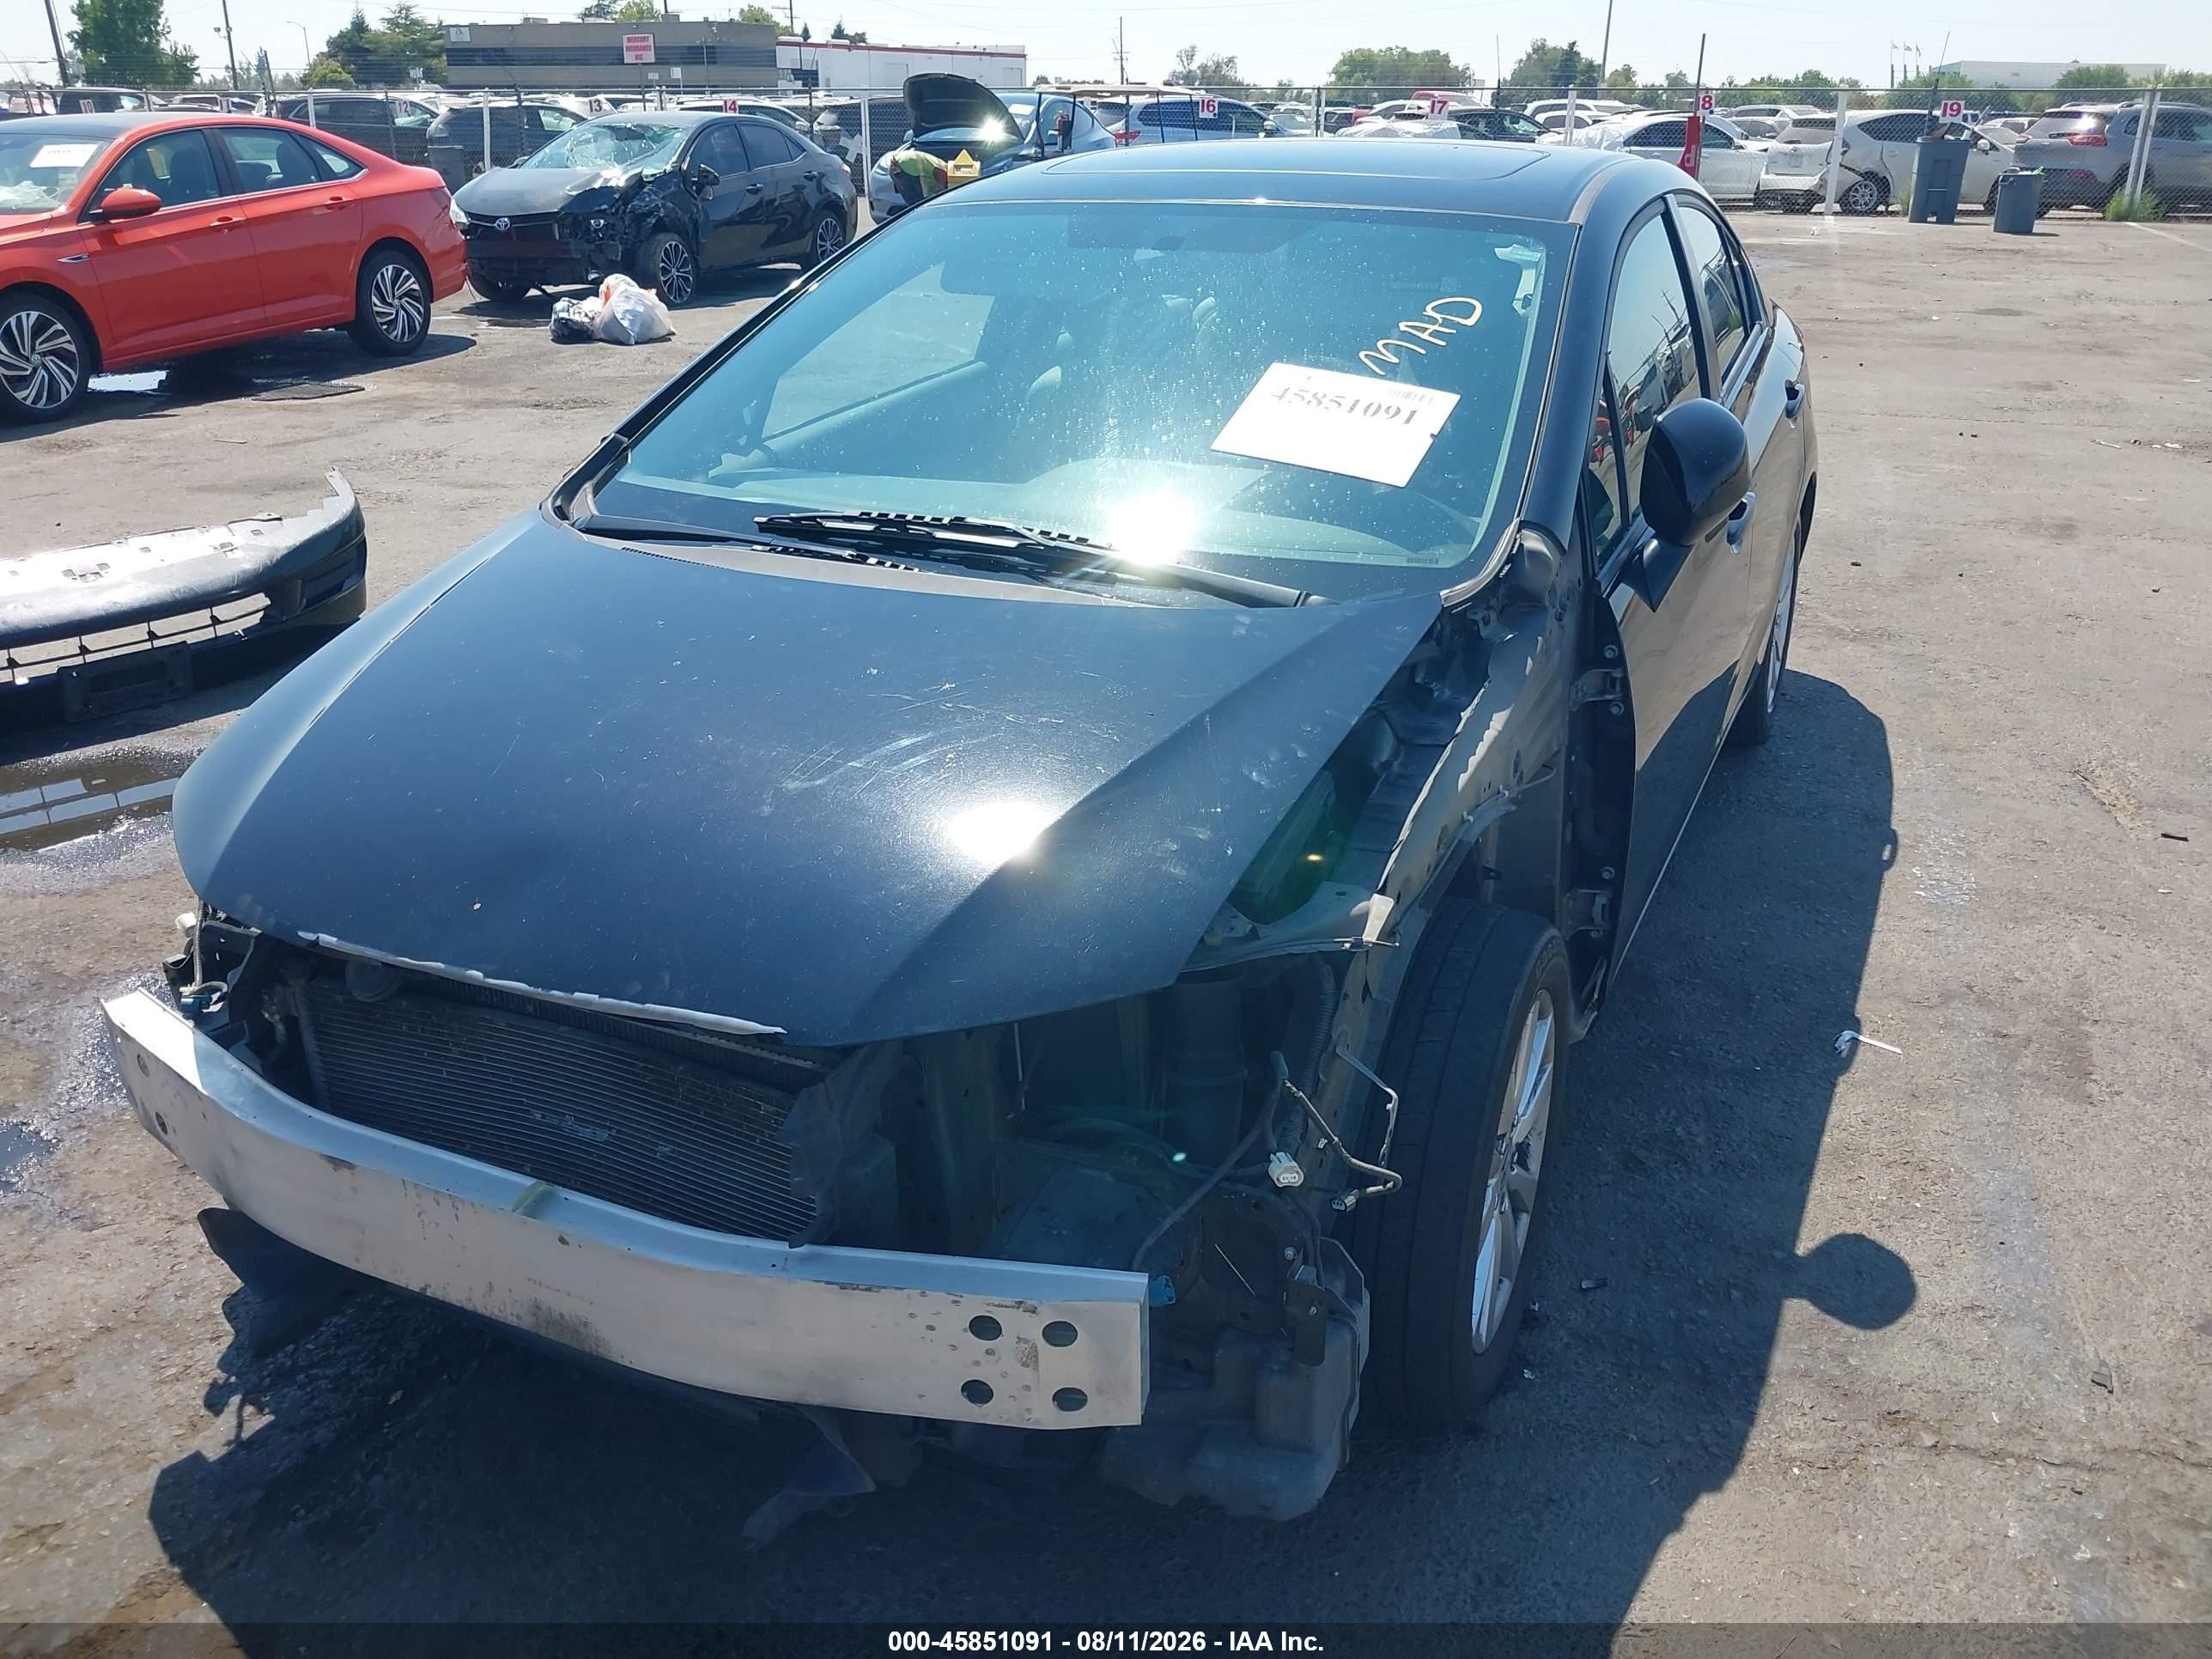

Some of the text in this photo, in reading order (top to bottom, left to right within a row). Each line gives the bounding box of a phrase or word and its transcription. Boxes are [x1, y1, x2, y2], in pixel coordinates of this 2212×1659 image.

[82, 100, 94, 113] 10
[398, 100, 409, 113] 12
[588, 99, 603, 112] 13
[723, 99, 738, 113] 14
[1200, 99, 1216, 113] 16
[1430, 99, 1448, 114] 17
[1942, 101, 1962, 118] 19
[1358, 296, 1483, 376] MAD
[1270, 386, 1419, 425] 45851091
